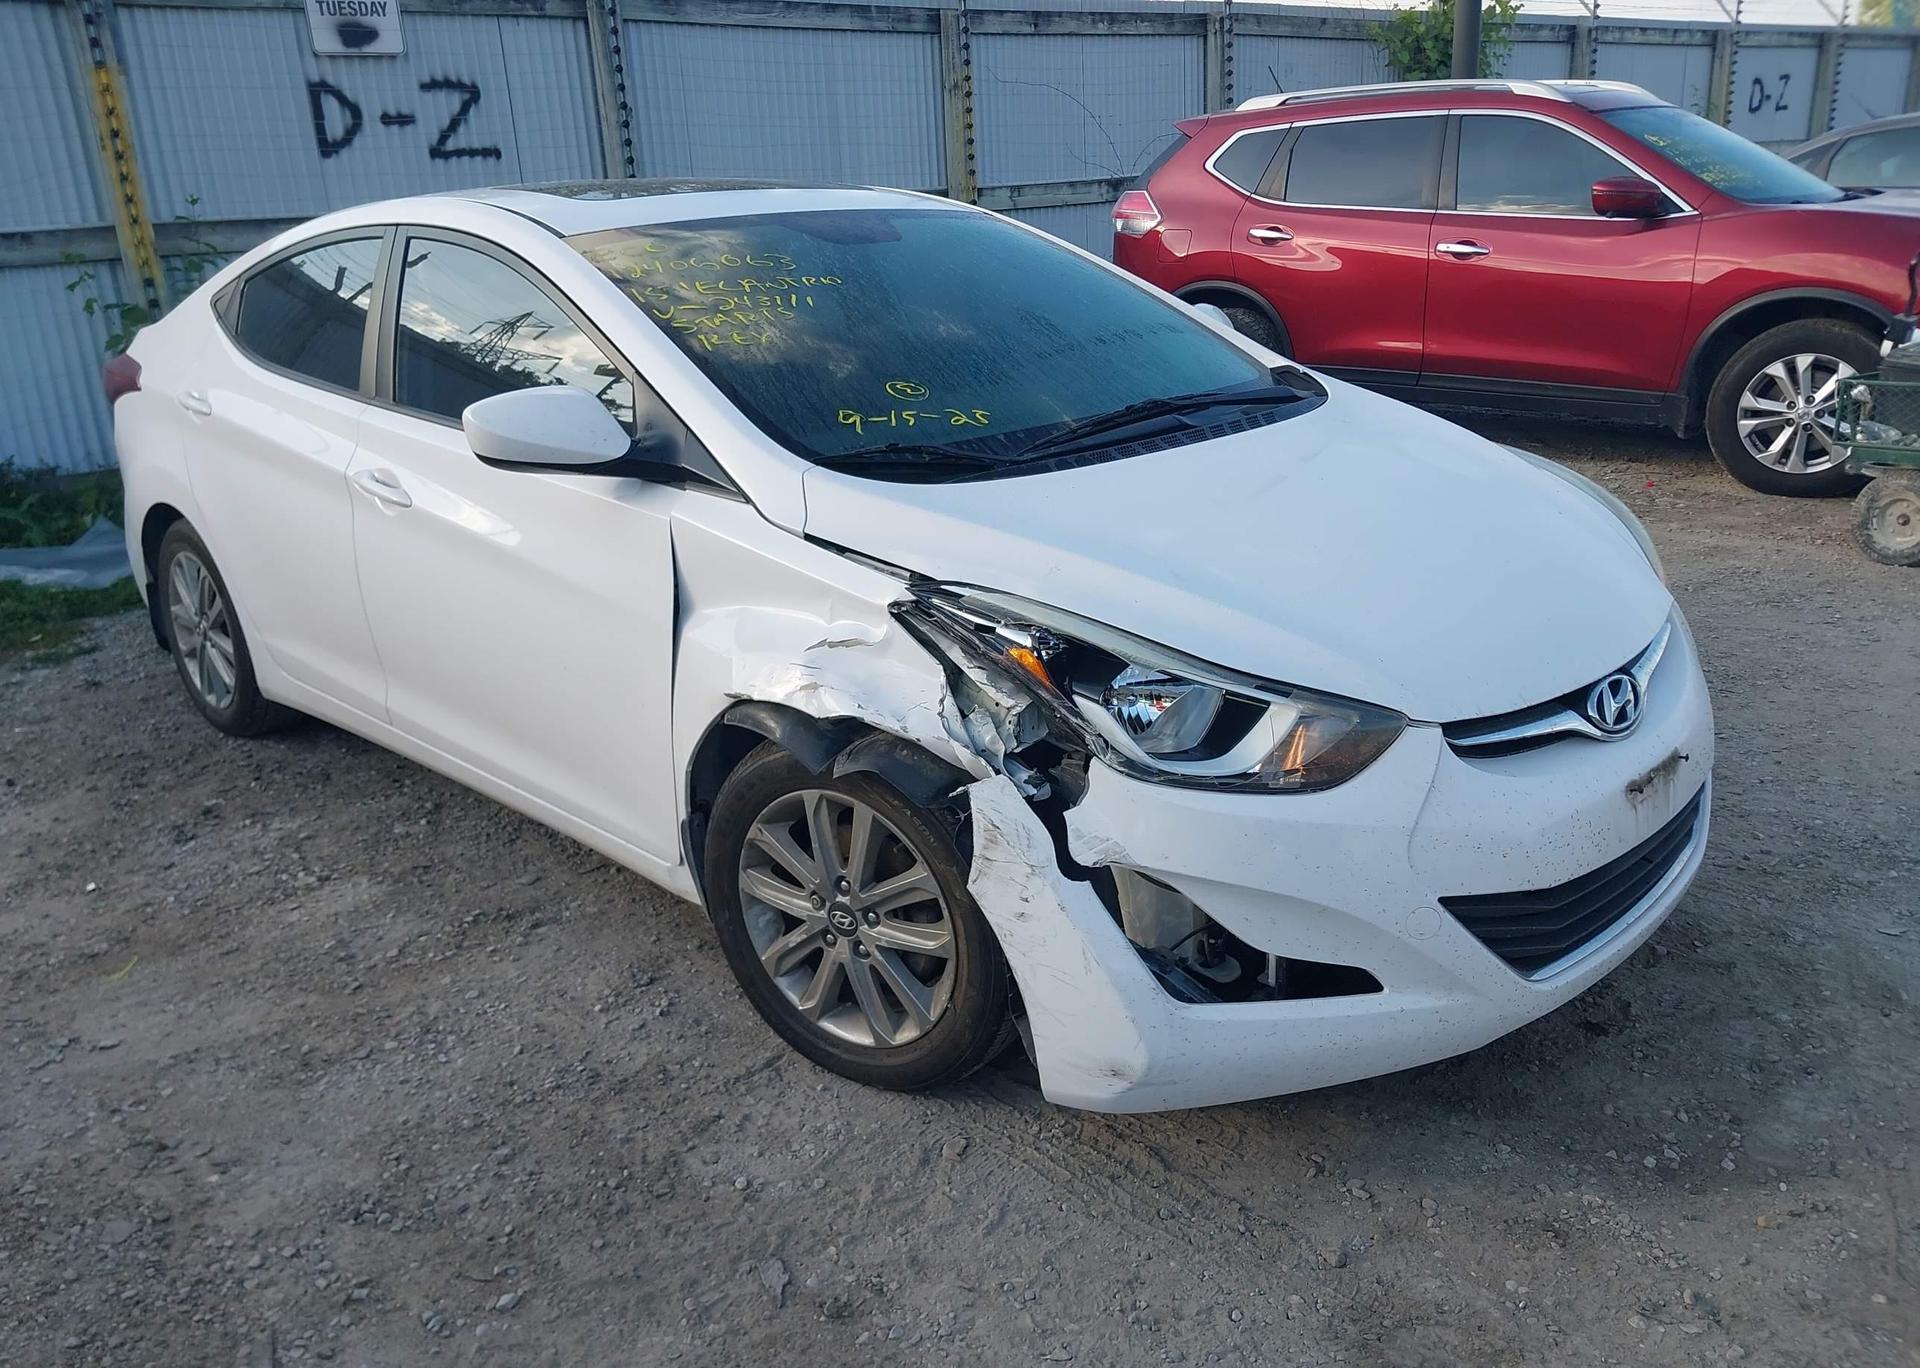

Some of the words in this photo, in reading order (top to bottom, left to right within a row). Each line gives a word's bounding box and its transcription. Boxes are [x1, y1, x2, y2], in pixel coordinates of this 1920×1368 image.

[316, 0, 387, 17] TUESDAY
[1748, 74, 1790, 113] D-Z
[308, 78, 502, 159] D-Z
[670, 306, 795, 334] STARTS
[837, 408, 992, 436] 9-15-25
